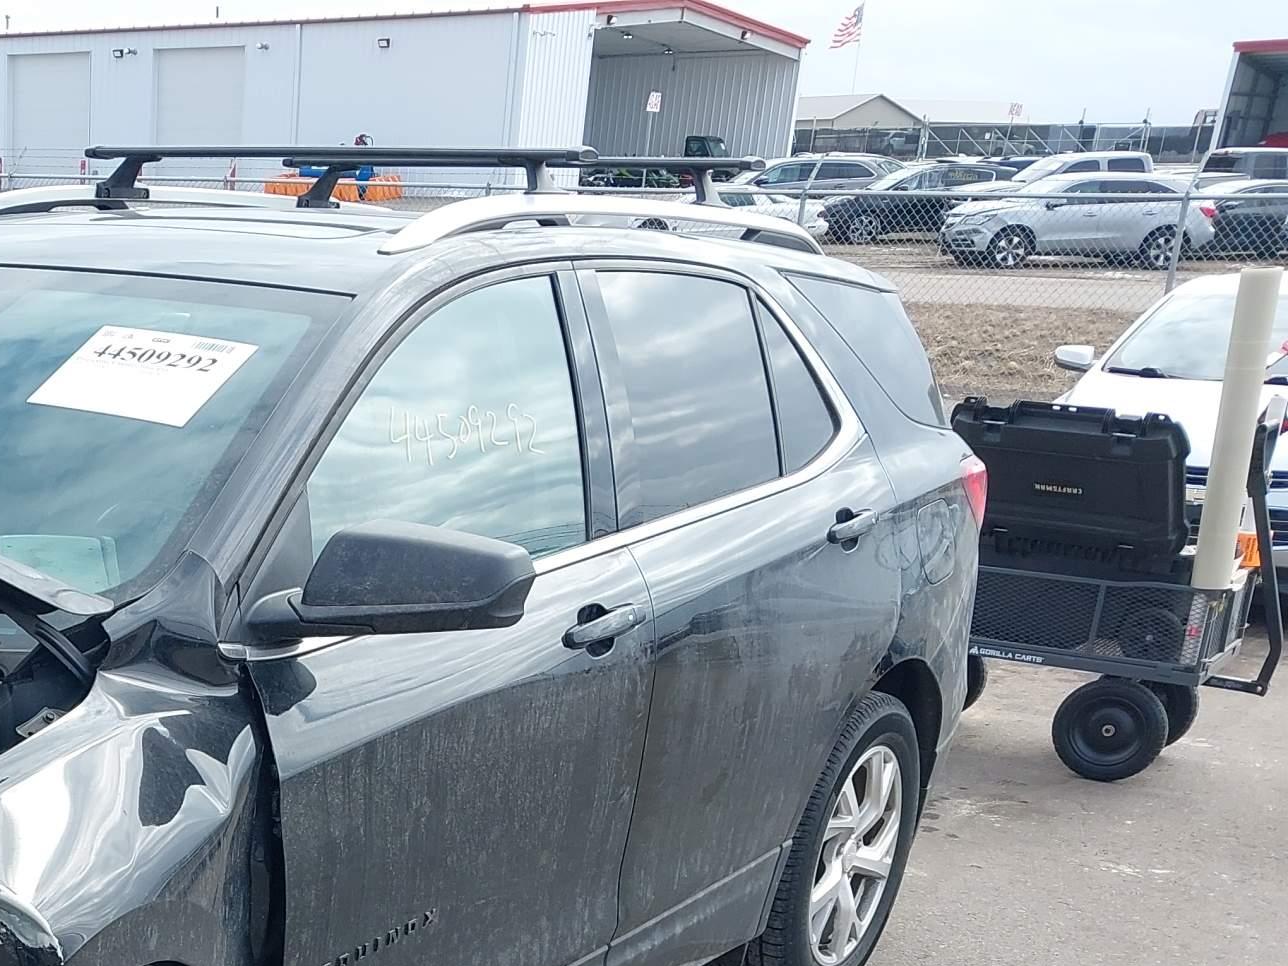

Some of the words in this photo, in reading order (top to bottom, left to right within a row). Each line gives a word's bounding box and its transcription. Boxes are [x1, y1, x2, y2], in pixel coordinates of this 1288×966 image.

[93, 344, 219, 372] 44509292
[389, 403, 546, 466] 44509292
[1033, 483, 1083, 495] CRAFTSMAN
[979, 647, 1013, 659] GORILLA
[1014, 653, 1044, 664] CARTS
